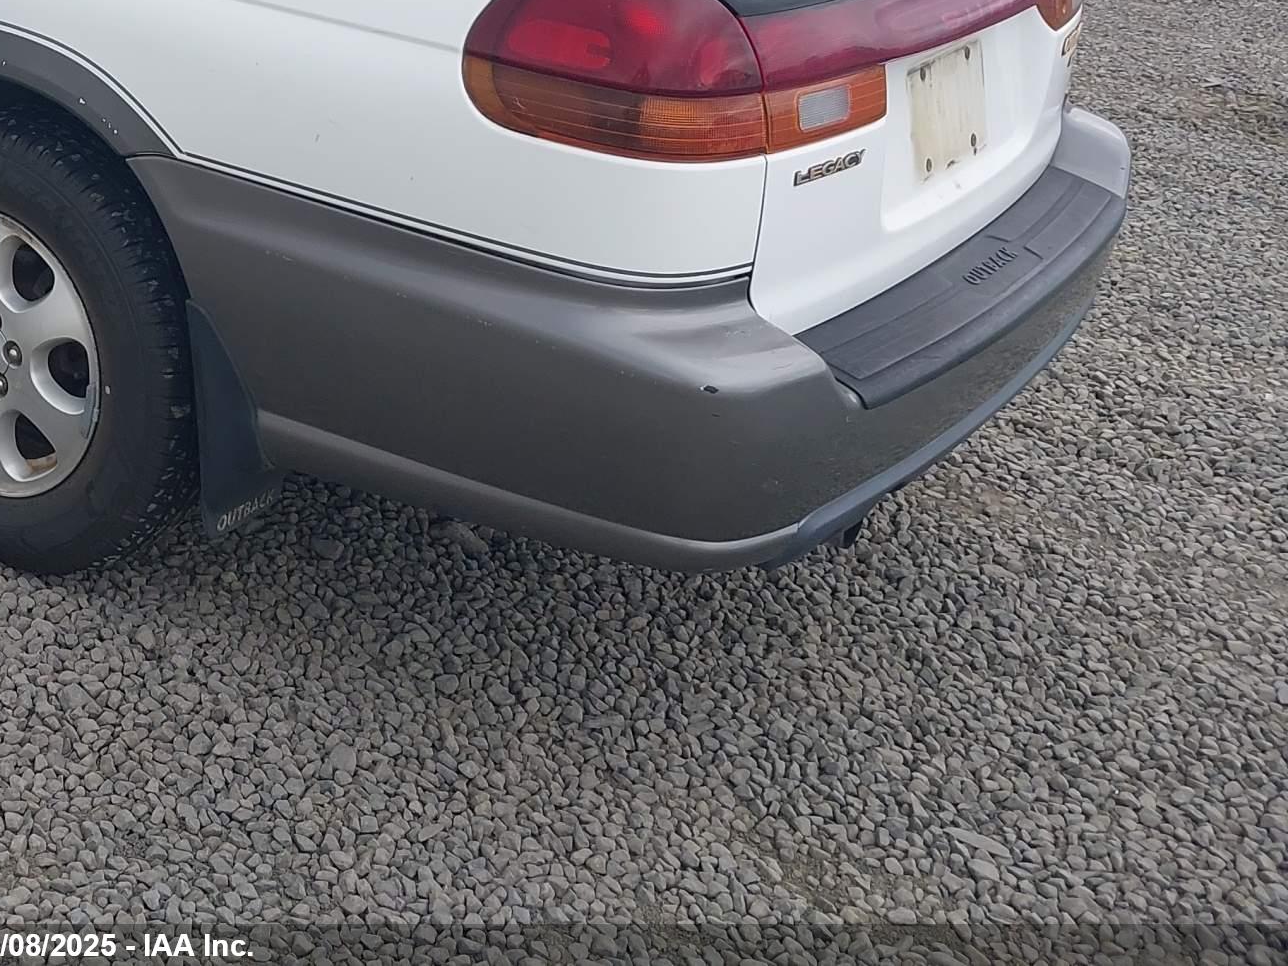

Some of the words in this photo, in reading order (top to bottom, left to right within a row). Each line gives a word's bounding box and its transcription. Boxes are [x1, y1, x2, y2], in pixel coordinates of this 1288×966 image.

[793, 148, 866, 187] LEGACY
[961, 246, 1018, 286] OUTBACK
[216, 489, 274, 531] OUTBACK
